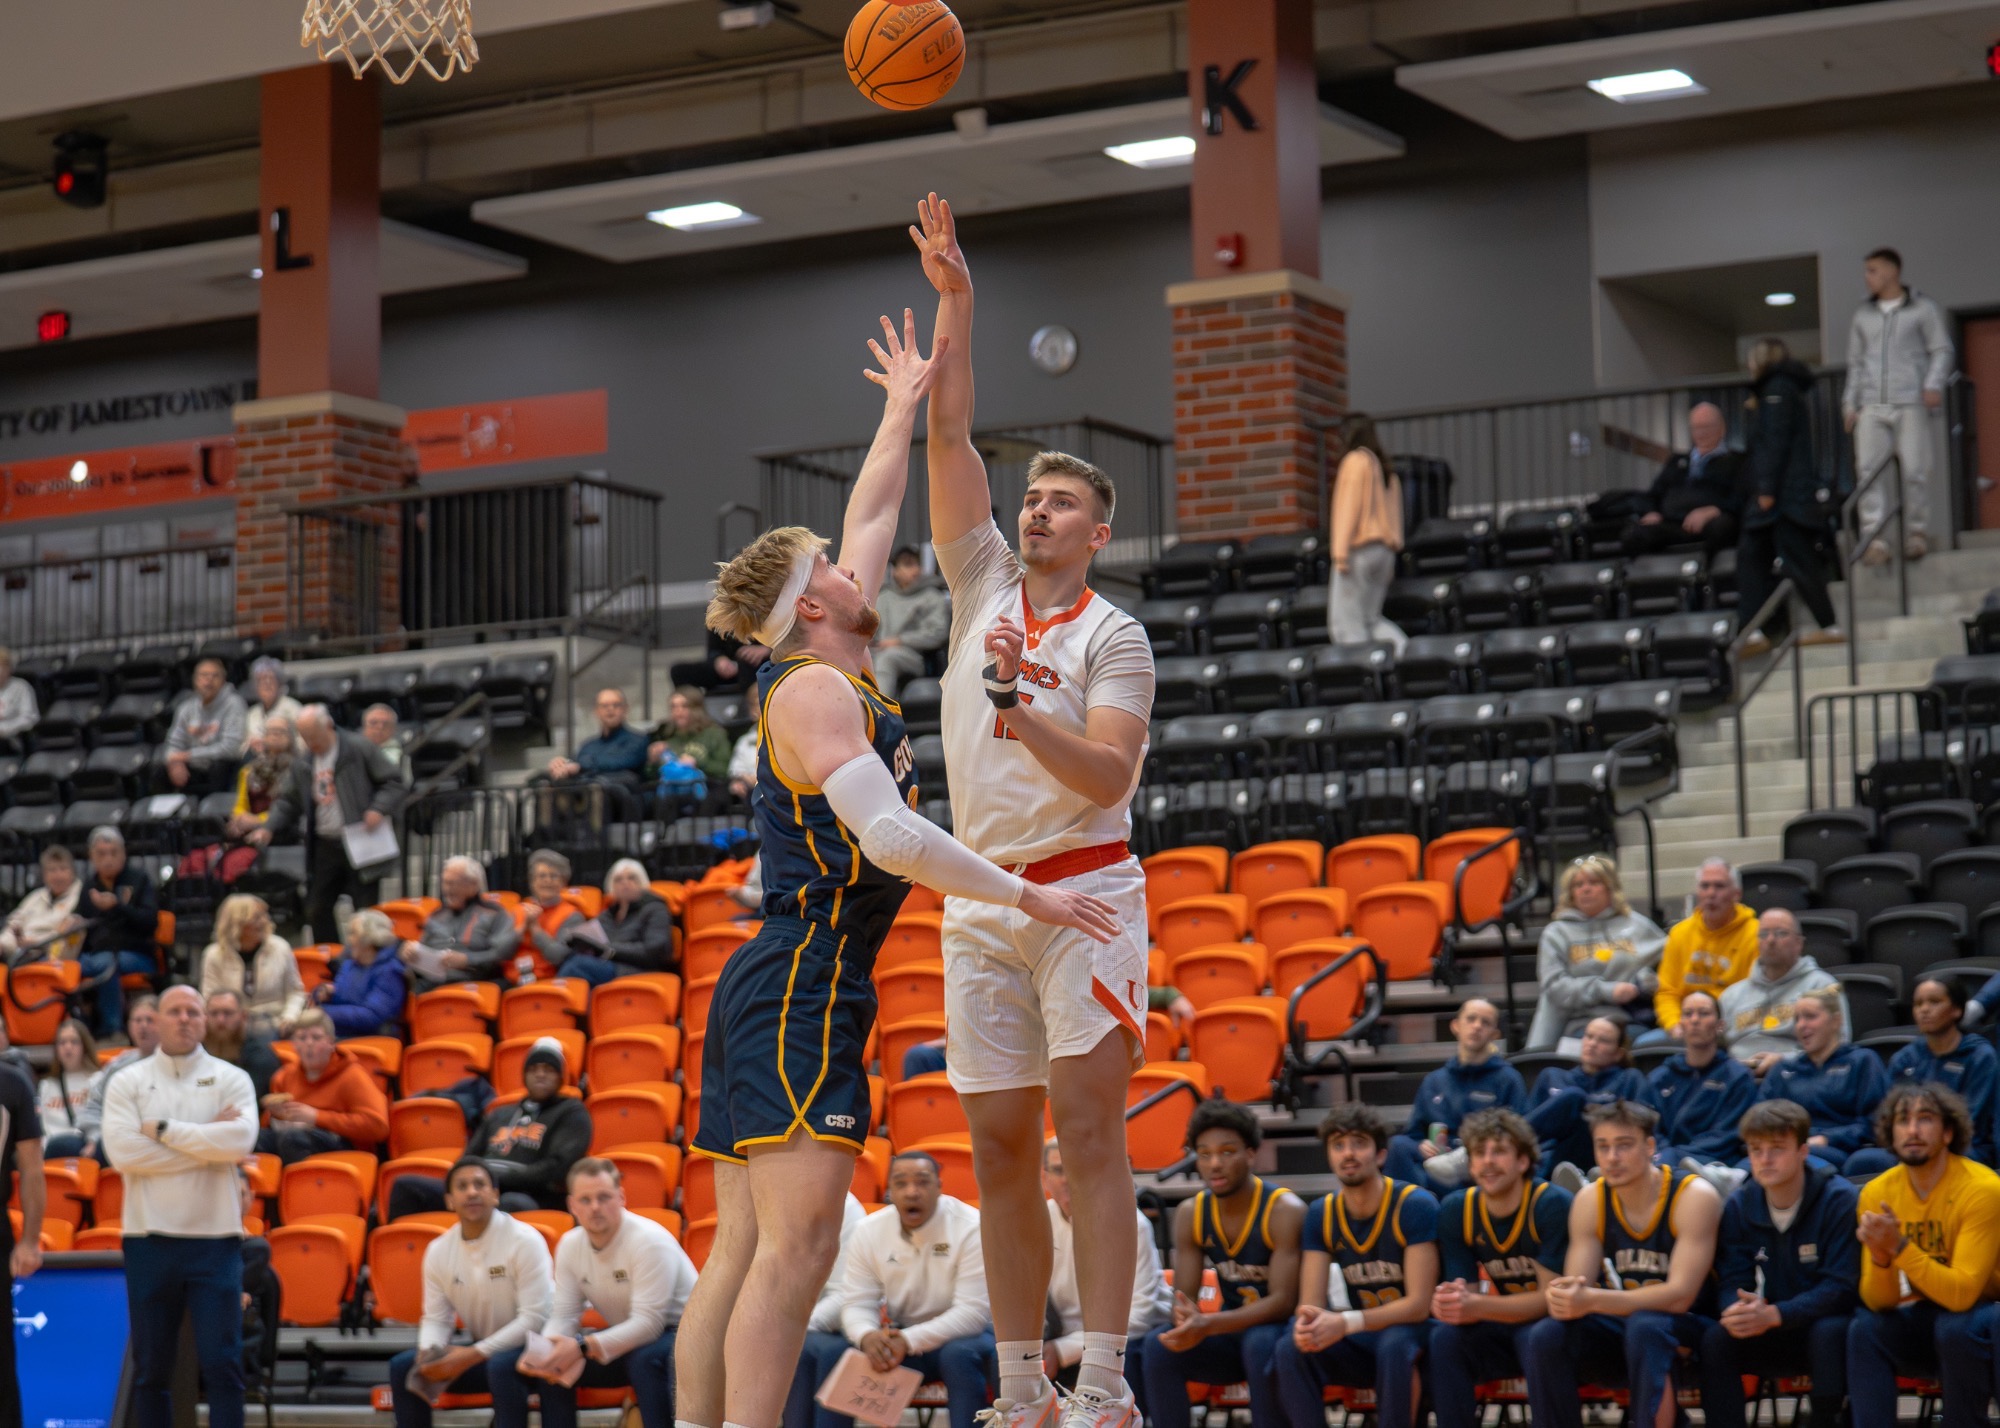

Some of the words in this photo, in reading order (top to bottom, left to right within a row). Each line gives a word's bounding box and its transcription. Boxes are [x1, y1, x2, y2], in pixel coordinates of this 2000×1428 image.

[1203, 60, 1259, 135] K
[271, 208, 313, 271] L
[29, 403, 65, 434] OF
[69, 384, 236, 432] JAMESTOWN
[894, 734, 915, 783] GO
[1126, 979, 1144, 1011] U
[825, 1114, 856, 1129] CSP
